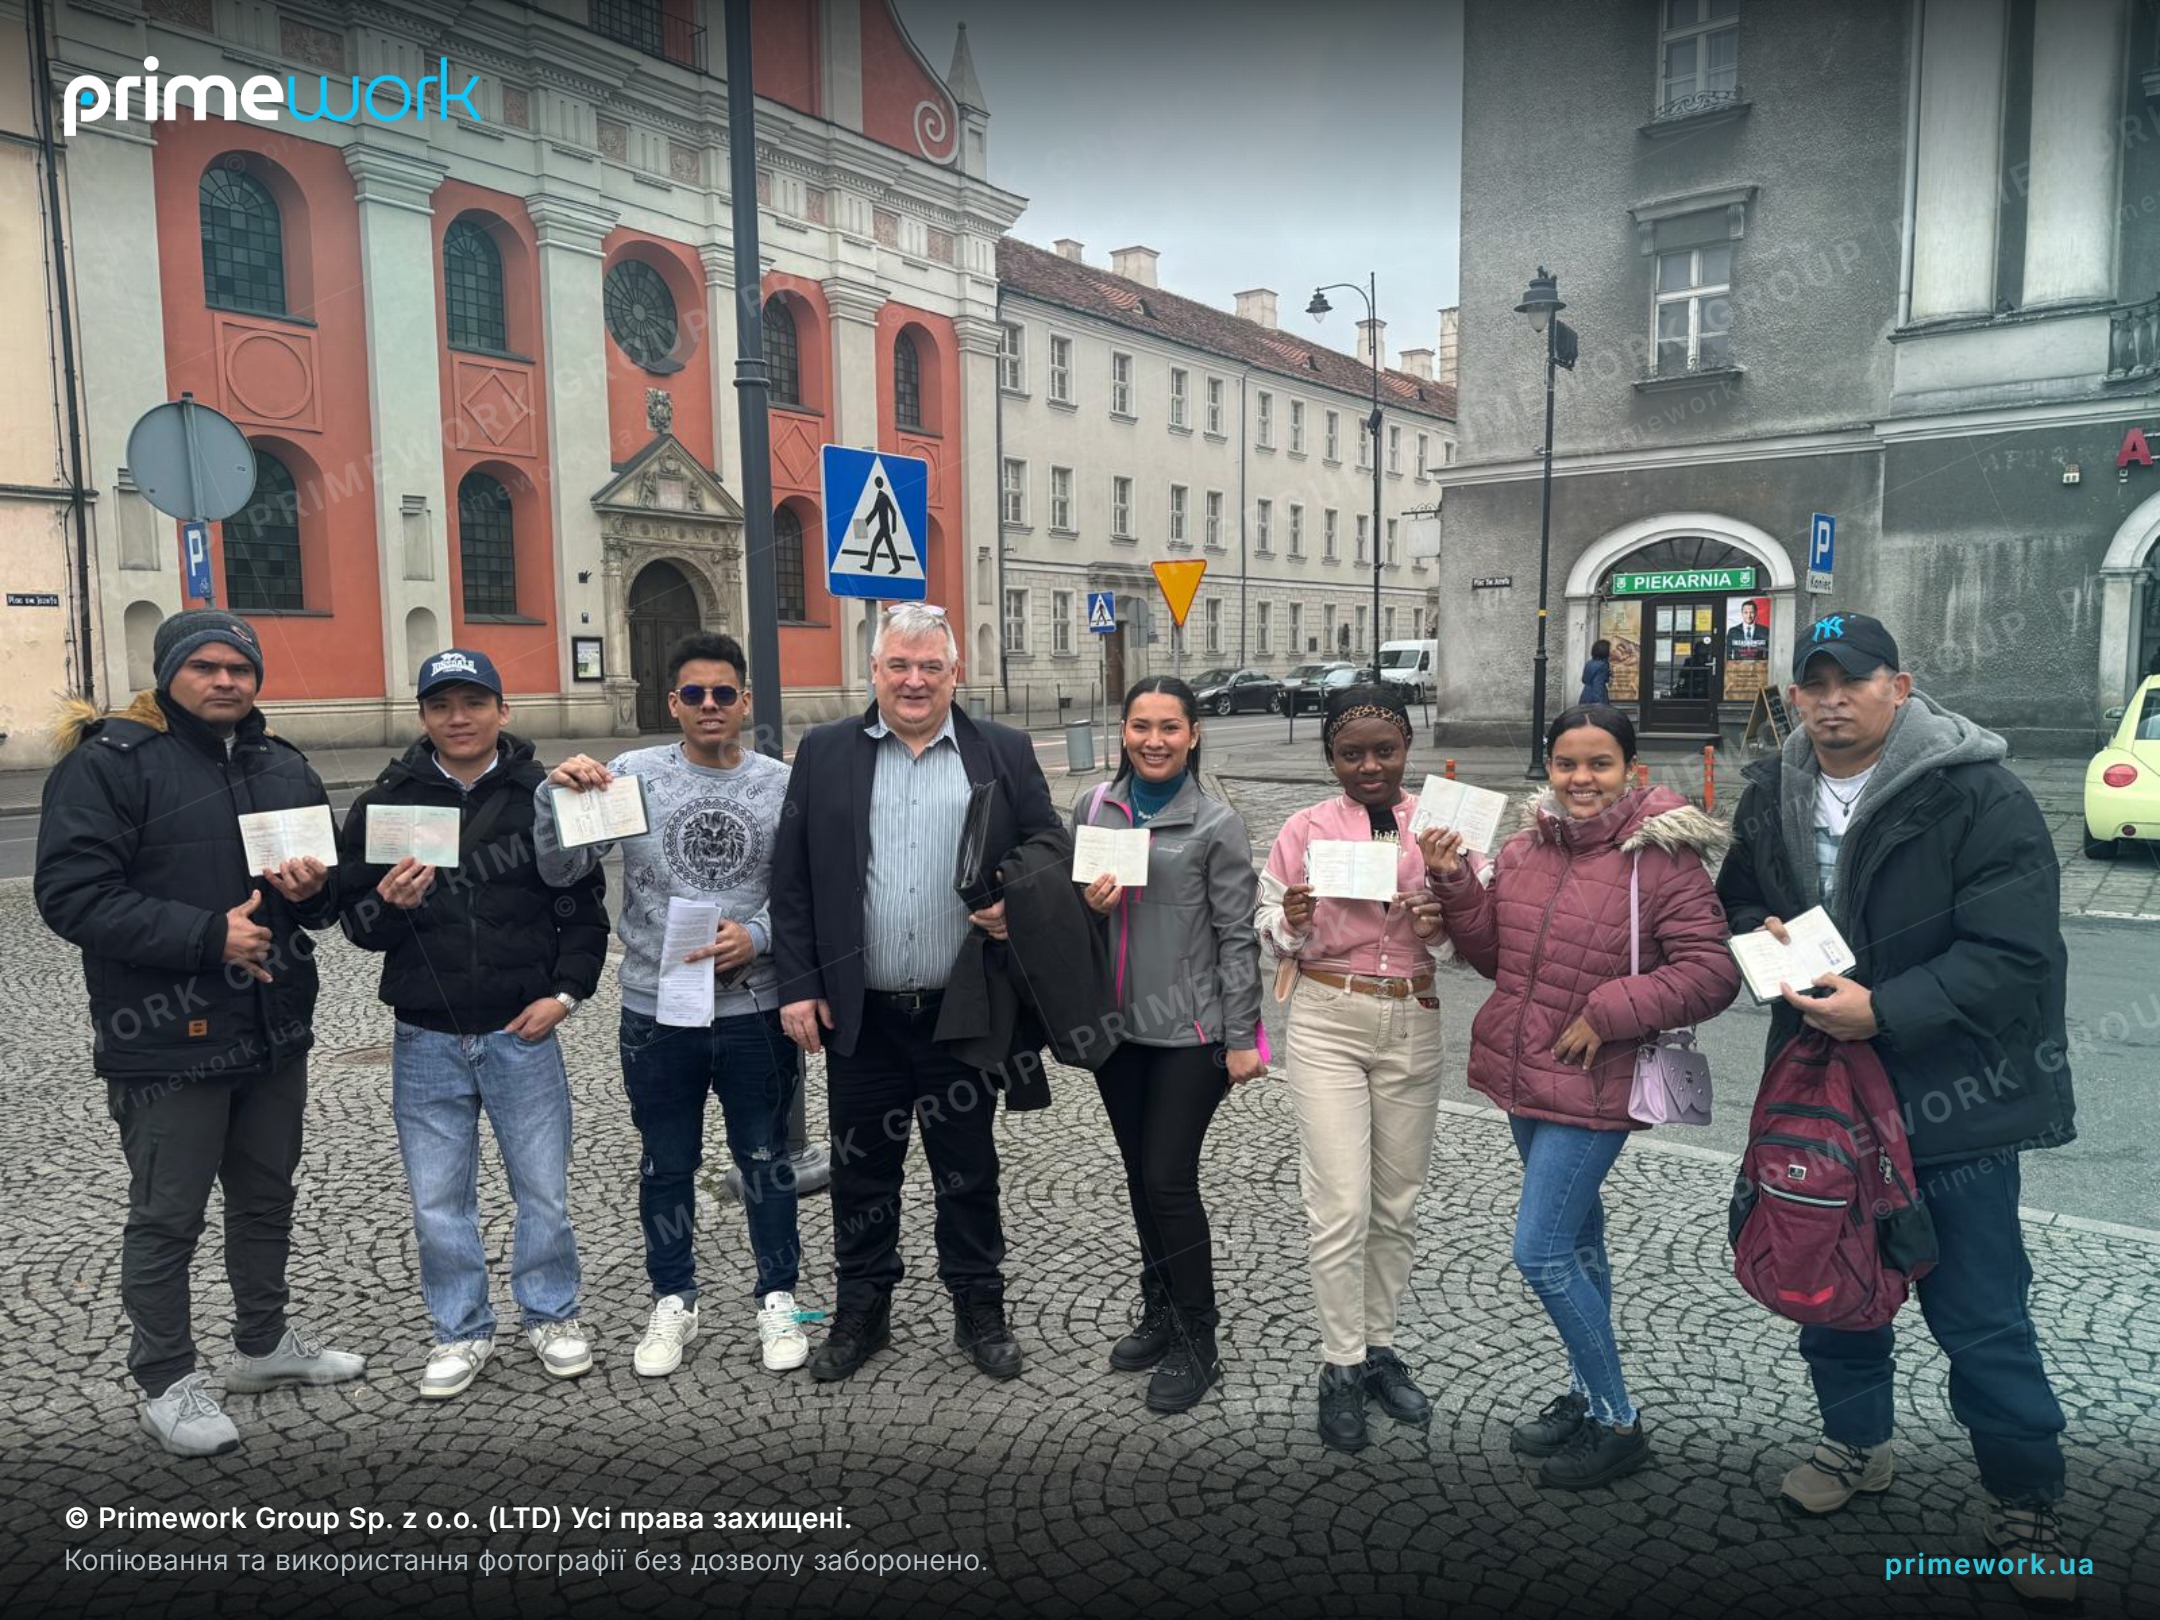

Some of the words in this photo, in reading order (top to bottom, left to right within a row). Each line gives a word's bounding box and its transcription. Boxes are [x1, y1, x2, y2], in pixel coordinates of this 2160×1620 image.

[188, 529, 203, 577] P
[1816, 521, 1831, 563] P
[1634, 571, 1731, 590] PIEKARNIA
